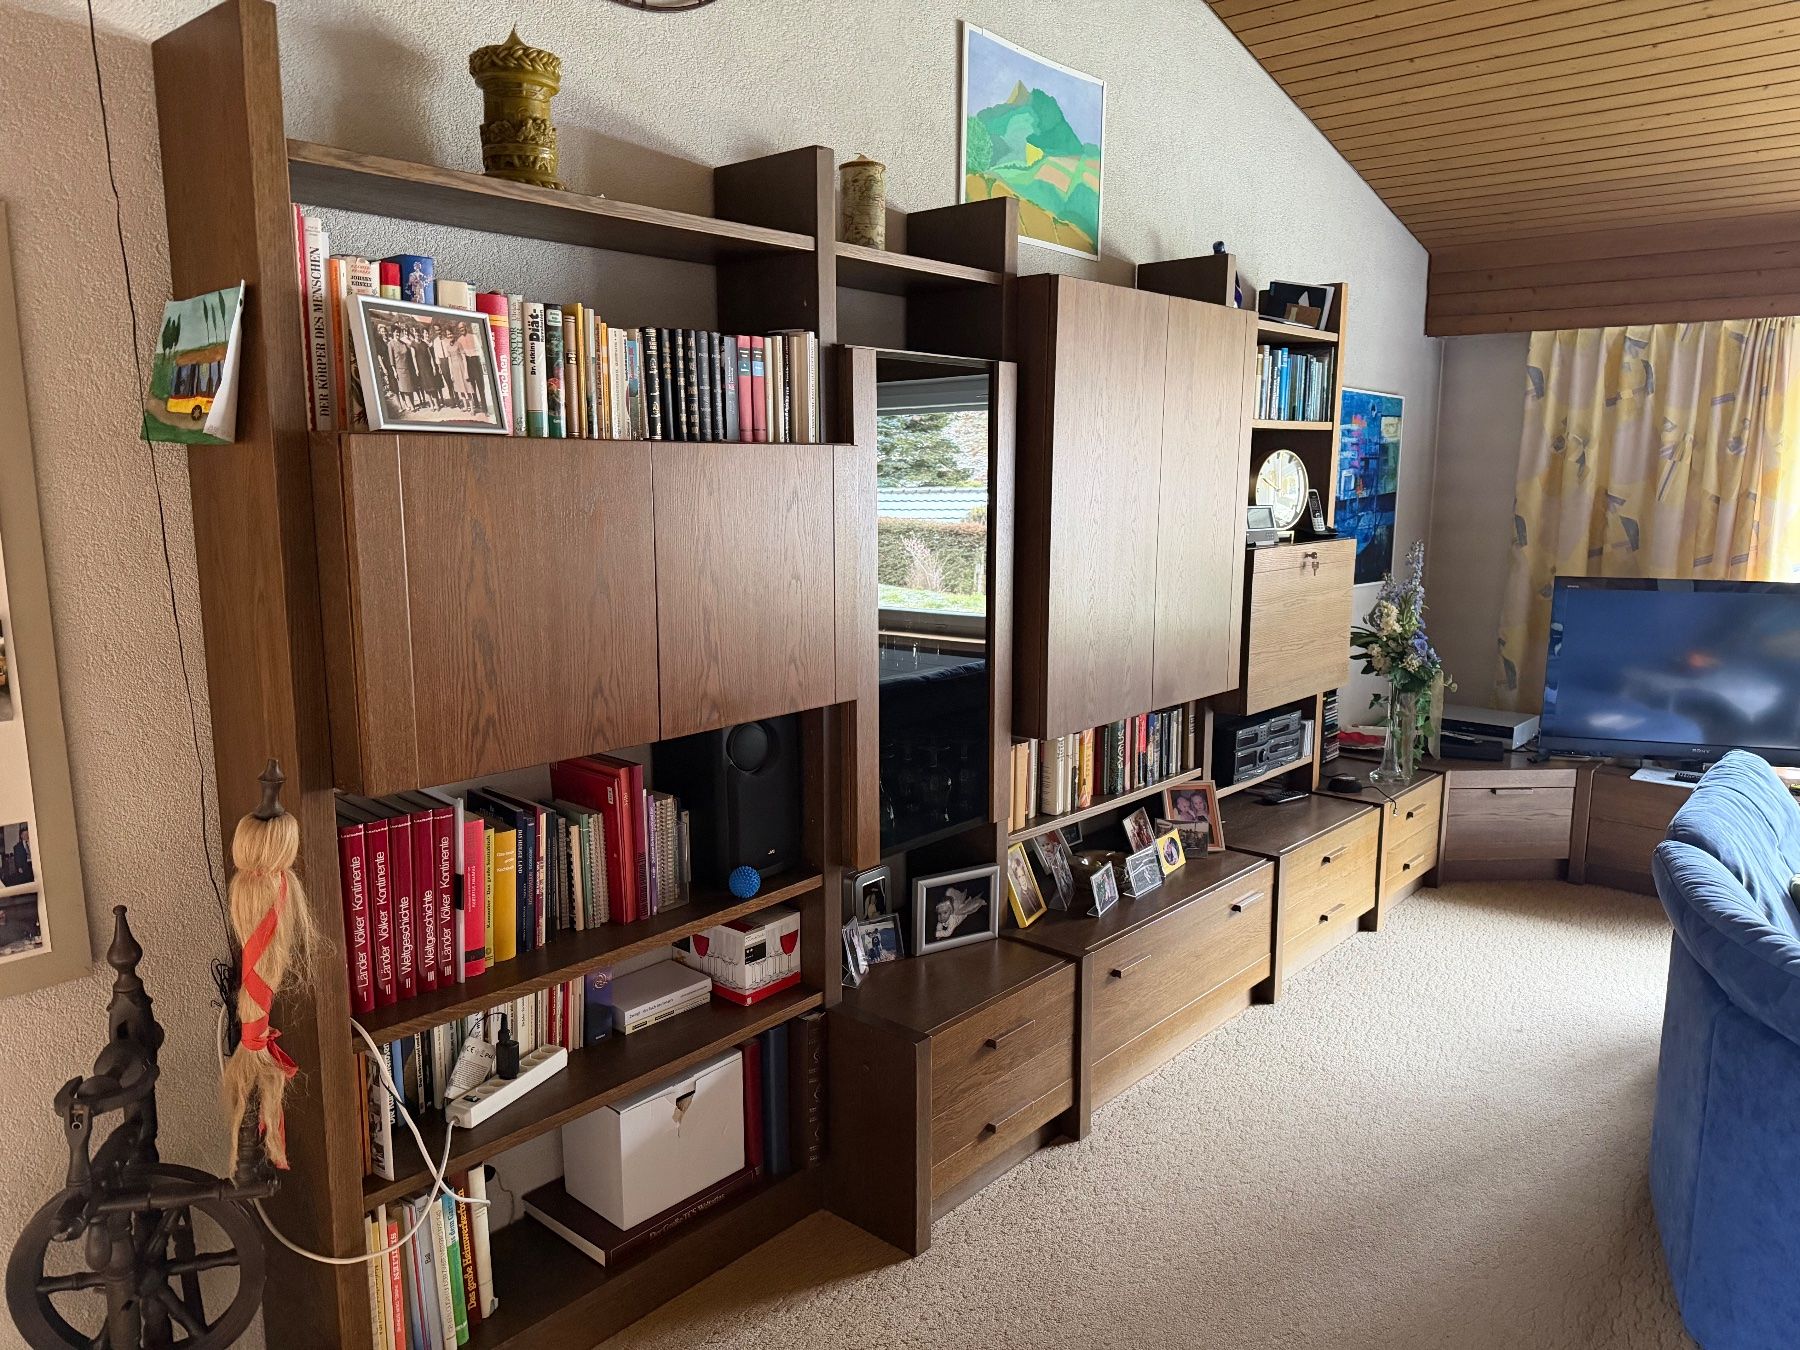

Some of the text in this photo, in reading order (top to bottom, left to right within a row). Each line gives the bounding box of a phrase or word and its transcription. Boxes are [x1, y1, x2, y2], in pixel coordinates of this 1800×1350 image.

[308, 246, 324, 313] MENSCHEN
[314, 312, 324, 340] DES
[528, 308, 540, 342] Diät-
[314, 342, 328, 390] KÖRPER
[510, 326, 518, 366] DOKTOR
[319, 392, 330, 418] DER
[375, 852, 387, 905] Kontinente
[440, 836, 450, 888] Kontinente
[352, 856, 363, 911] Kontinente
[378, 910, 388, 942] Völker
[422, 890, 436, 968] Weltgeschichte
[440, 894, 451, 924] Völker
[354, 916, 366, 948] Völker
[399, 896, 414, 975] Weltgeschichte
[441, 927, 452, 963] Länder
[357, 952, 368, 988] Länder
[380, 945, 392, 981] Länder
[390, 1232, 400, 1281] SIILIEN
[457, 1188, 476, 1310] Das große Heimwerkerbuh
